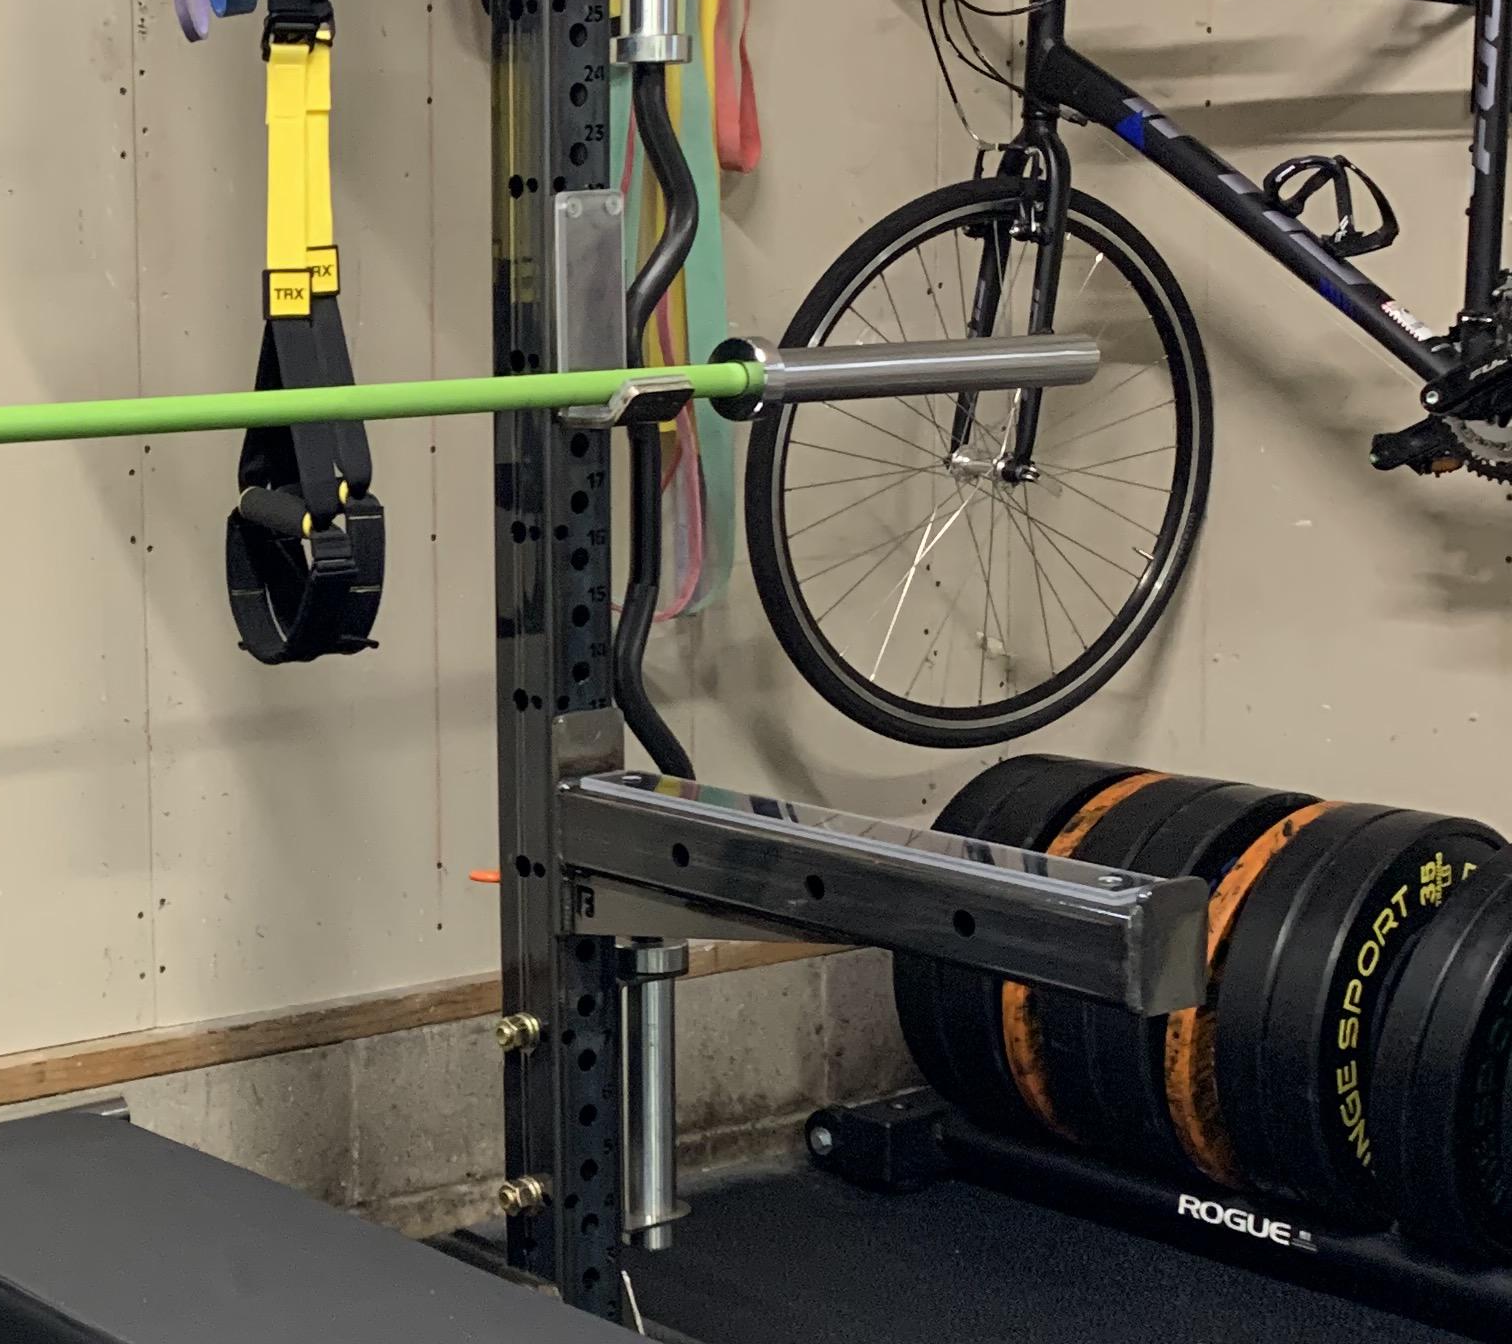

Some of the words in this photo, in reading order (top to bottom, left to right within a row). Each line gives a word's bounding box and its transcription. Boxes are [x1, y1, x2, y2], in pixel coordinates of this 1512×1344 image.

[584, 4, 605, 23] 25
[584, 64, 605, 83] 24
[584, 124, 605, 142] 23
[310, 264, 335, 277] RX
[274, 287, 305, 301] TRX
[1420, 861, 1437, 906] 35
[1337, 884, 1409, 1051] SPORT
[1177, 1193, 1292, 1246] ROGUE
